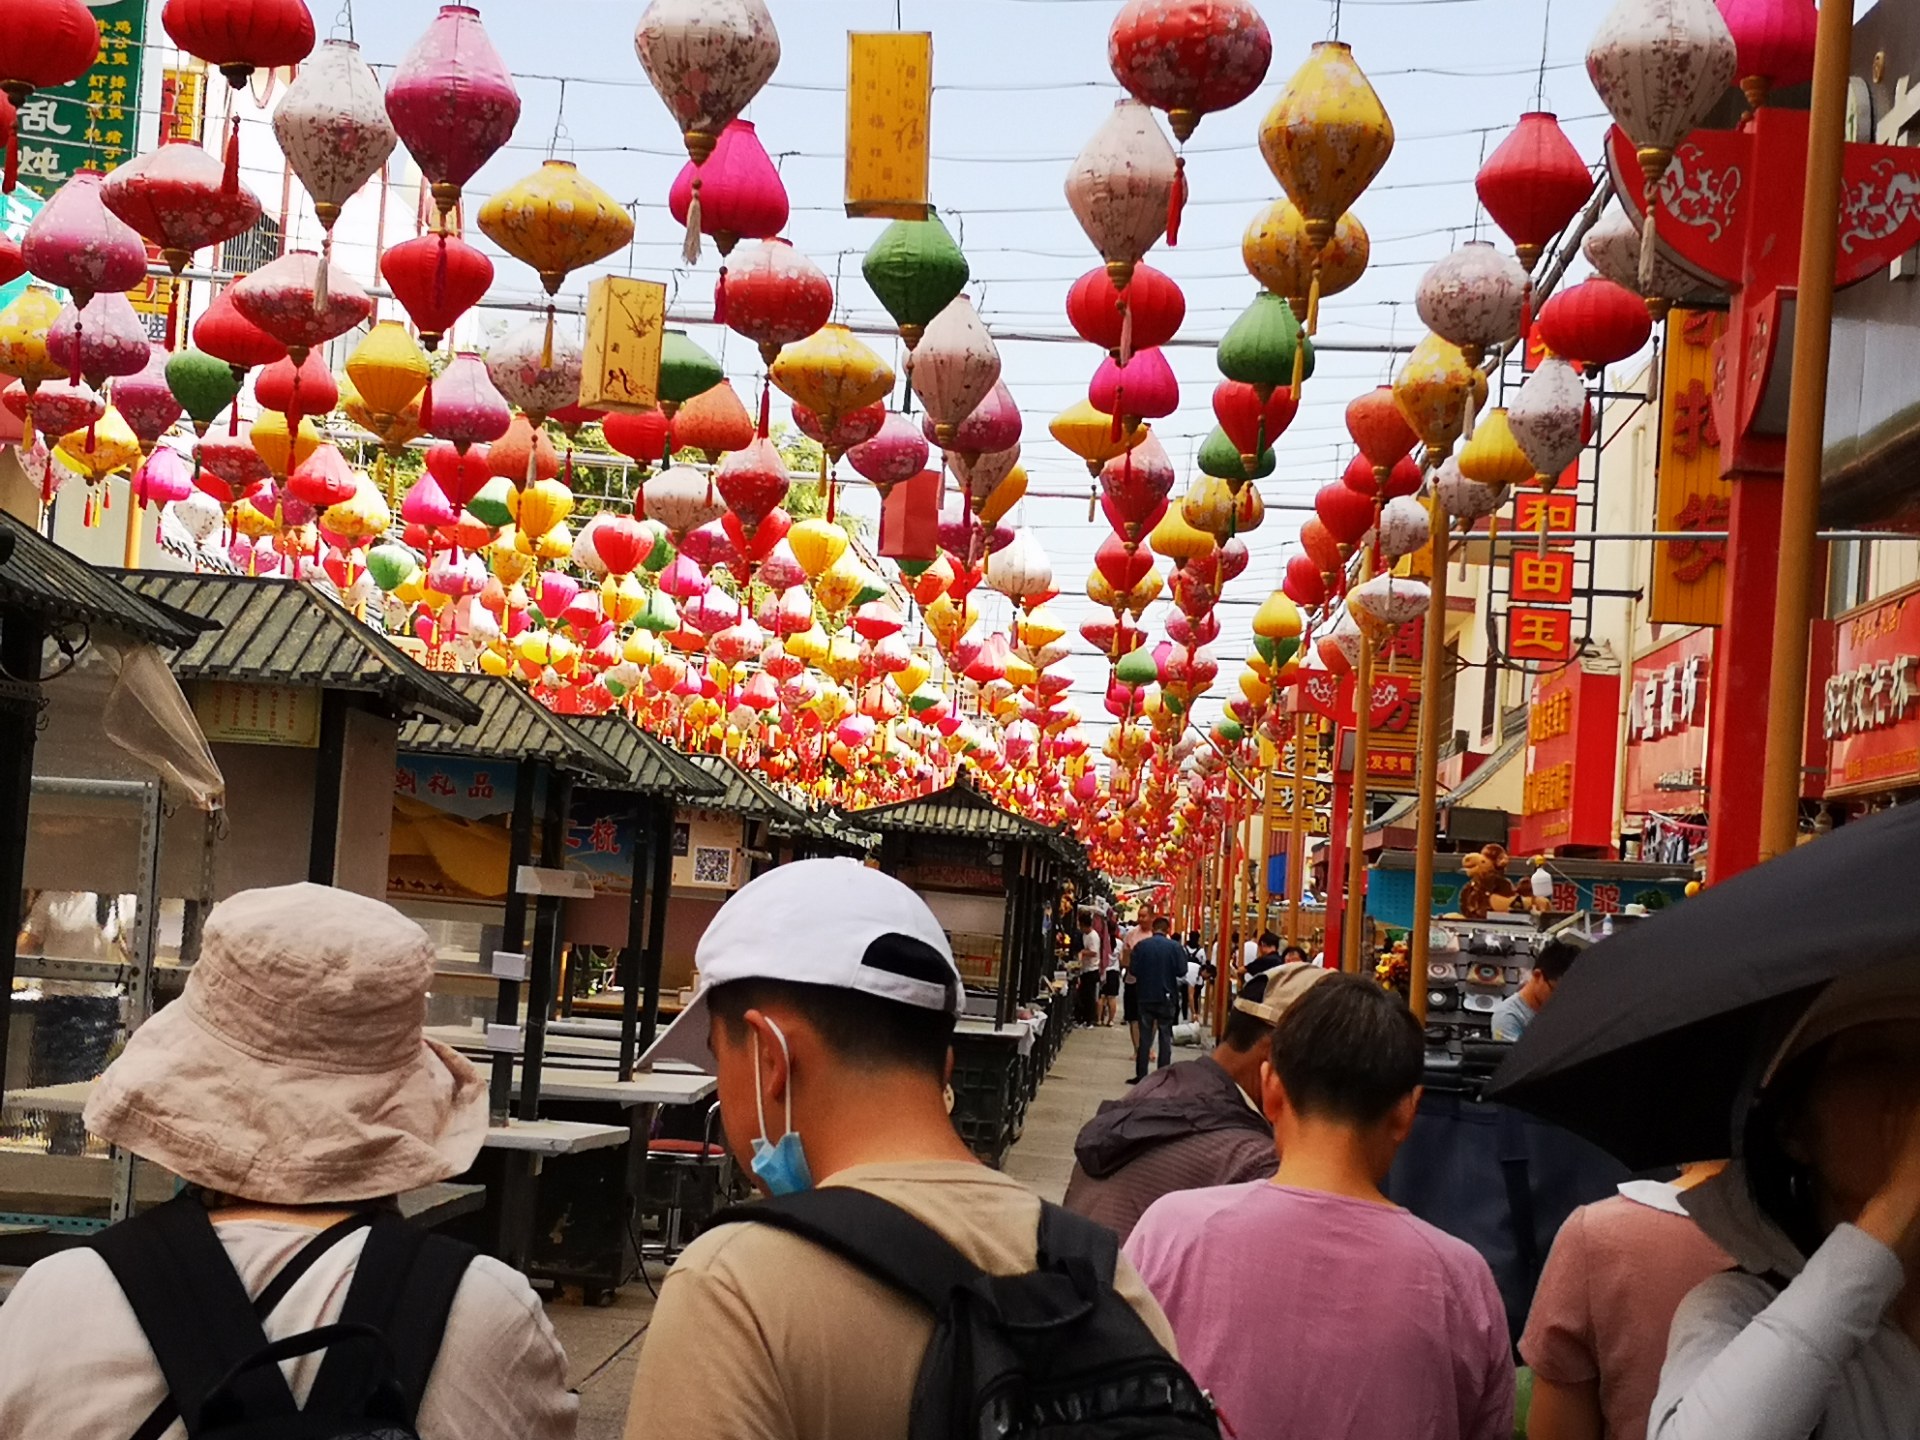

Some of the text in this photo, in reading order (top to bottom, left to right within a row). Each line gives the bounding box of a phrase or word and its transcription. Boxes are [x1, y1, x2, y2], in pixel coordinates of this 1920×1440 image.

[1512, 498, 1572, 651] 和田玉
[1366, 754, 1413, 771] 发零售
[1551, 883, 1621, 913] 骆驼
